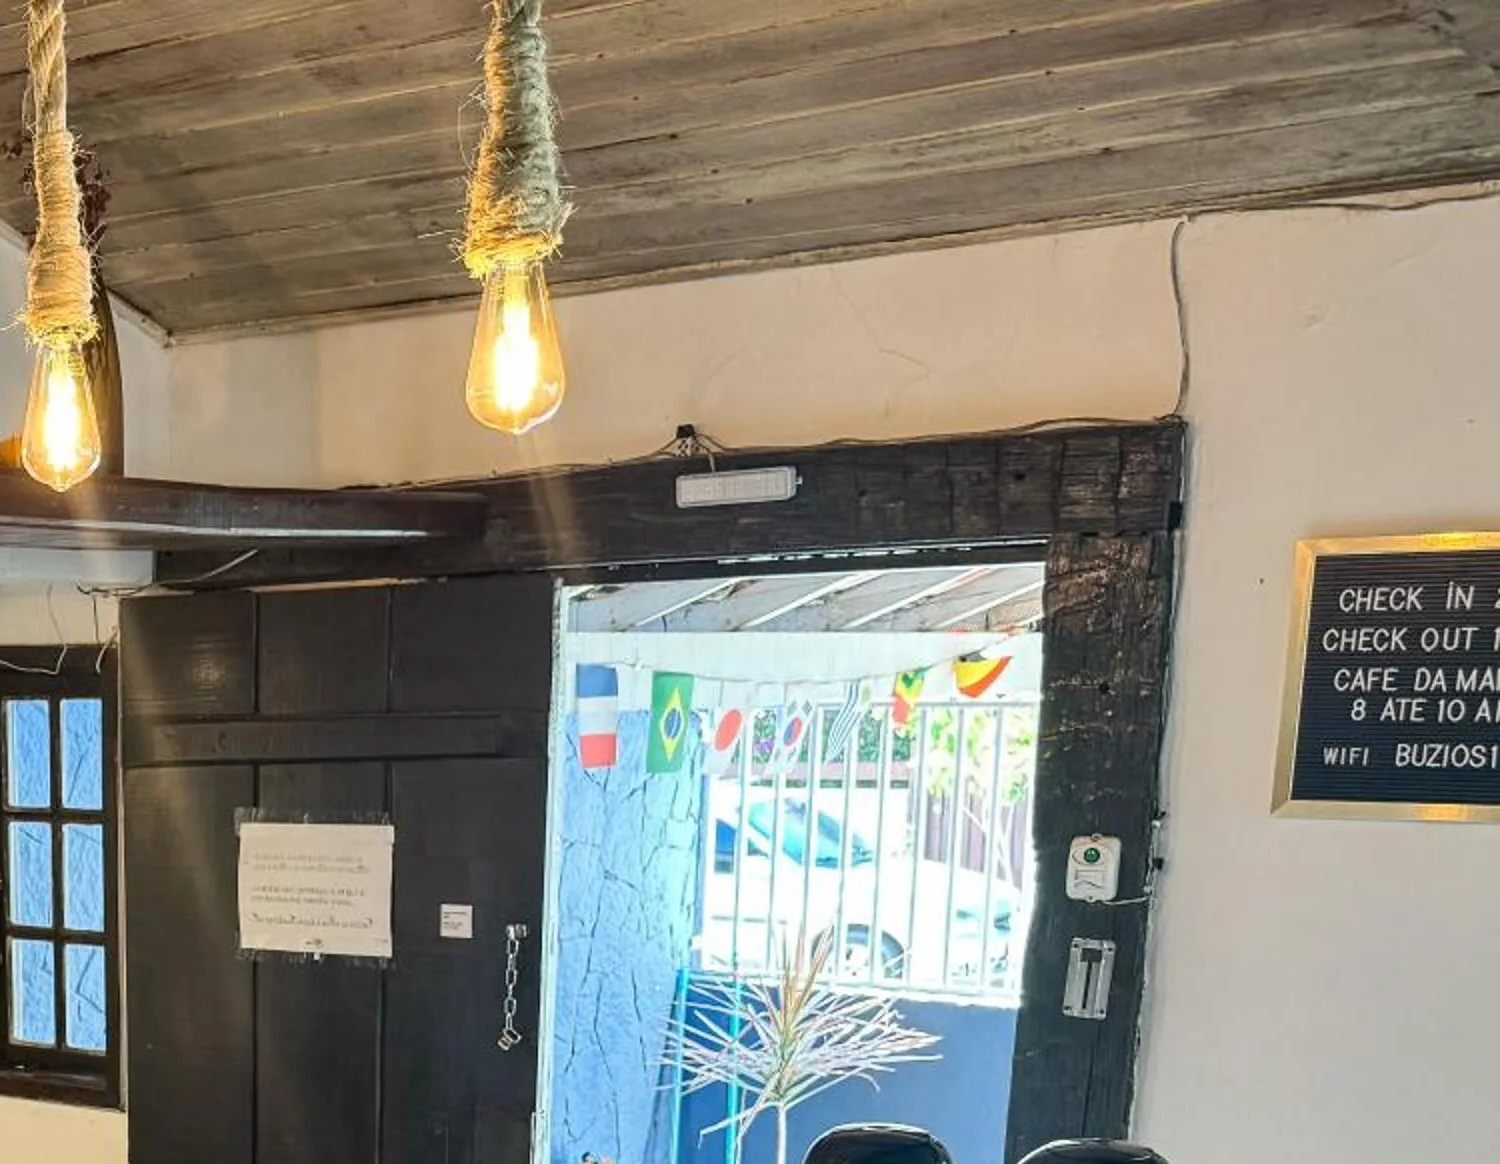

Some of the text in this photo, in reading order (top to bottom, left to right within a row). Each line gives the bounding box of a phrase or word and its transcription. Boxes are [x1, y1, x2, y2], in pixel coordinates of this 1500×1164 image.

[1339, 586, 1424, 613] CHECK
[1445, 581, 1475, 611] IN
[1322, 627, 1408, 652] CHECK
[1420, 627, 1480, 652] OUT
[1333, 666, 1500, 693] CAFE DA MA
[1350, 697, 1500, 724] 8 ATE 10 A
[1322, 747, 1369, 766] WIFI
